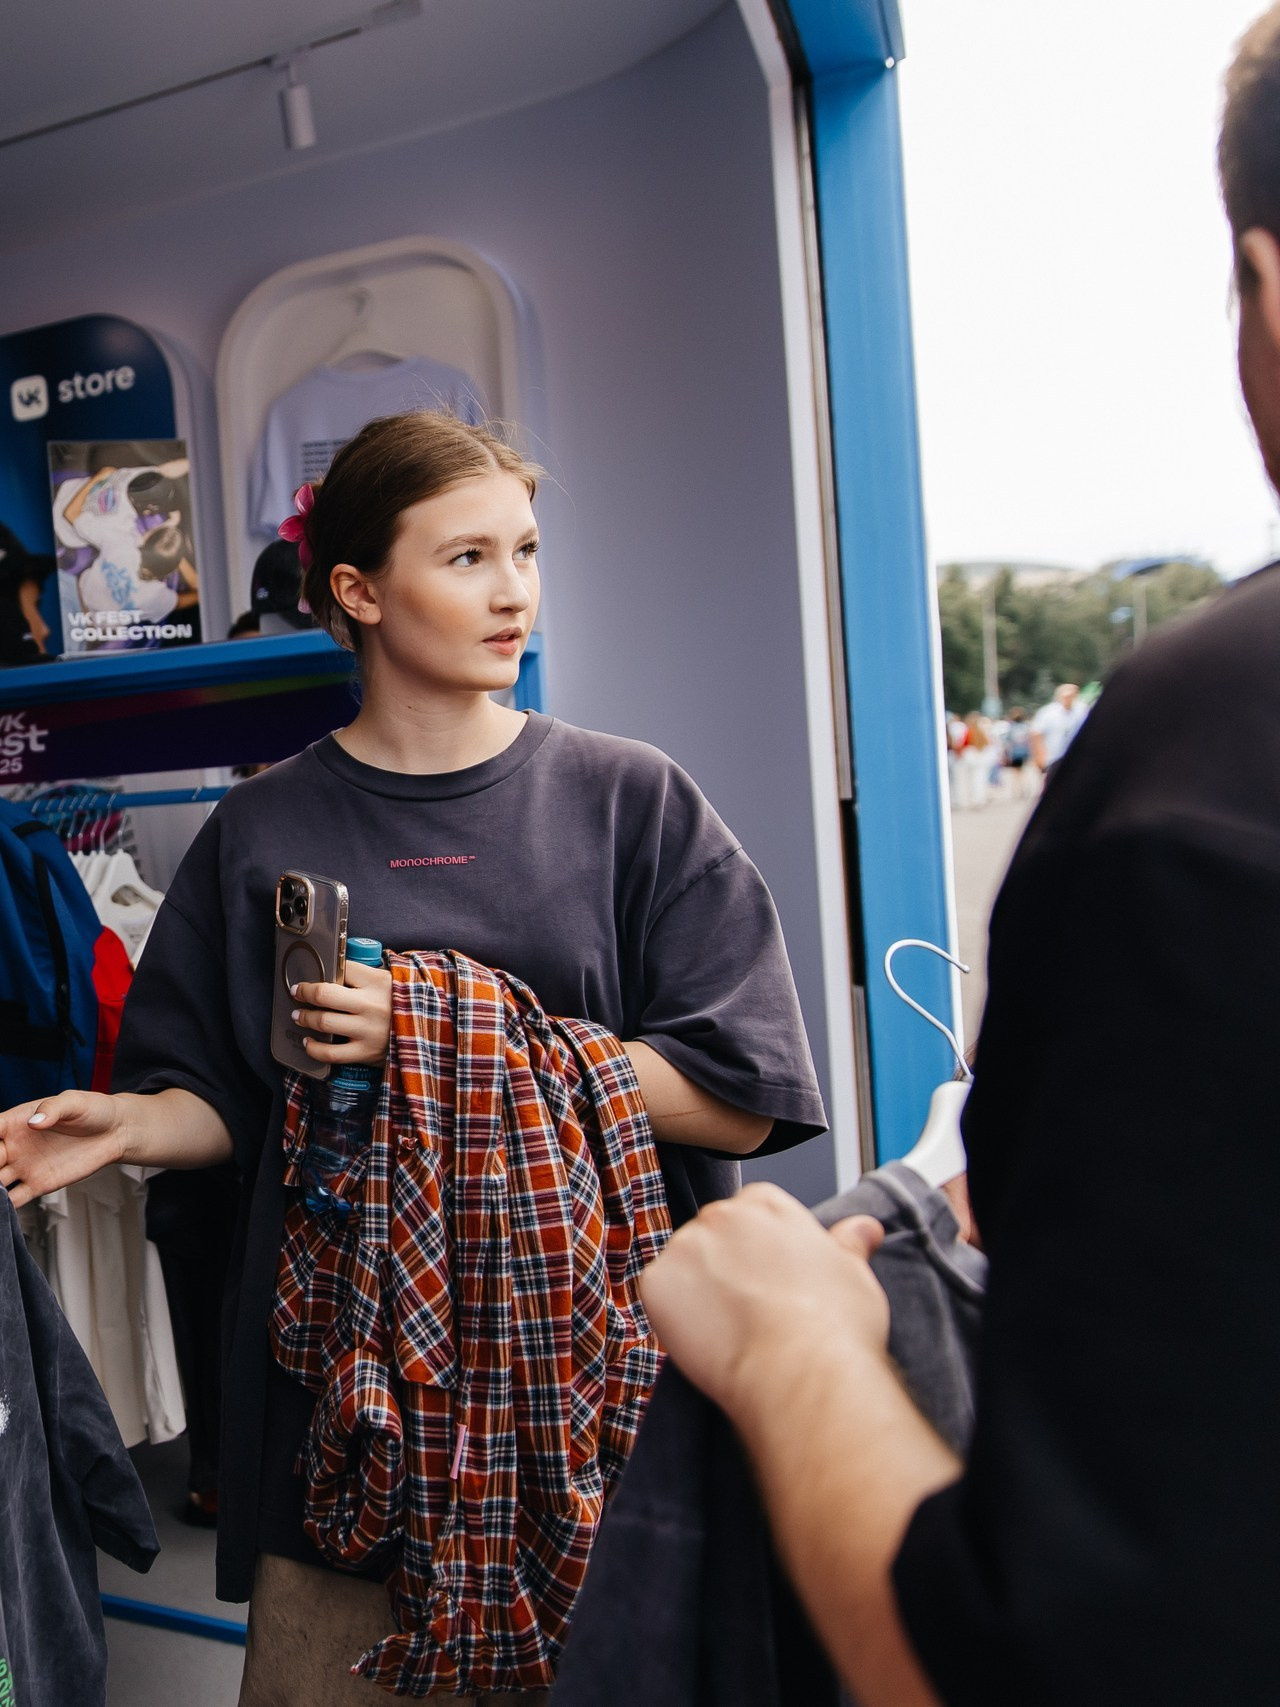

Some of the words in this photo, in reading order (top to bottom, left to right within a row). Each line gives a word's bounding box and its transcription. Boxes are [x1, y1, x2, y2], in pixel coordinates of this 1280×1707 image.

[58, 365, 135, 403] store
[95, 609, 144, 625] FEST
[70, 623, 193, 642] COLLECTION
